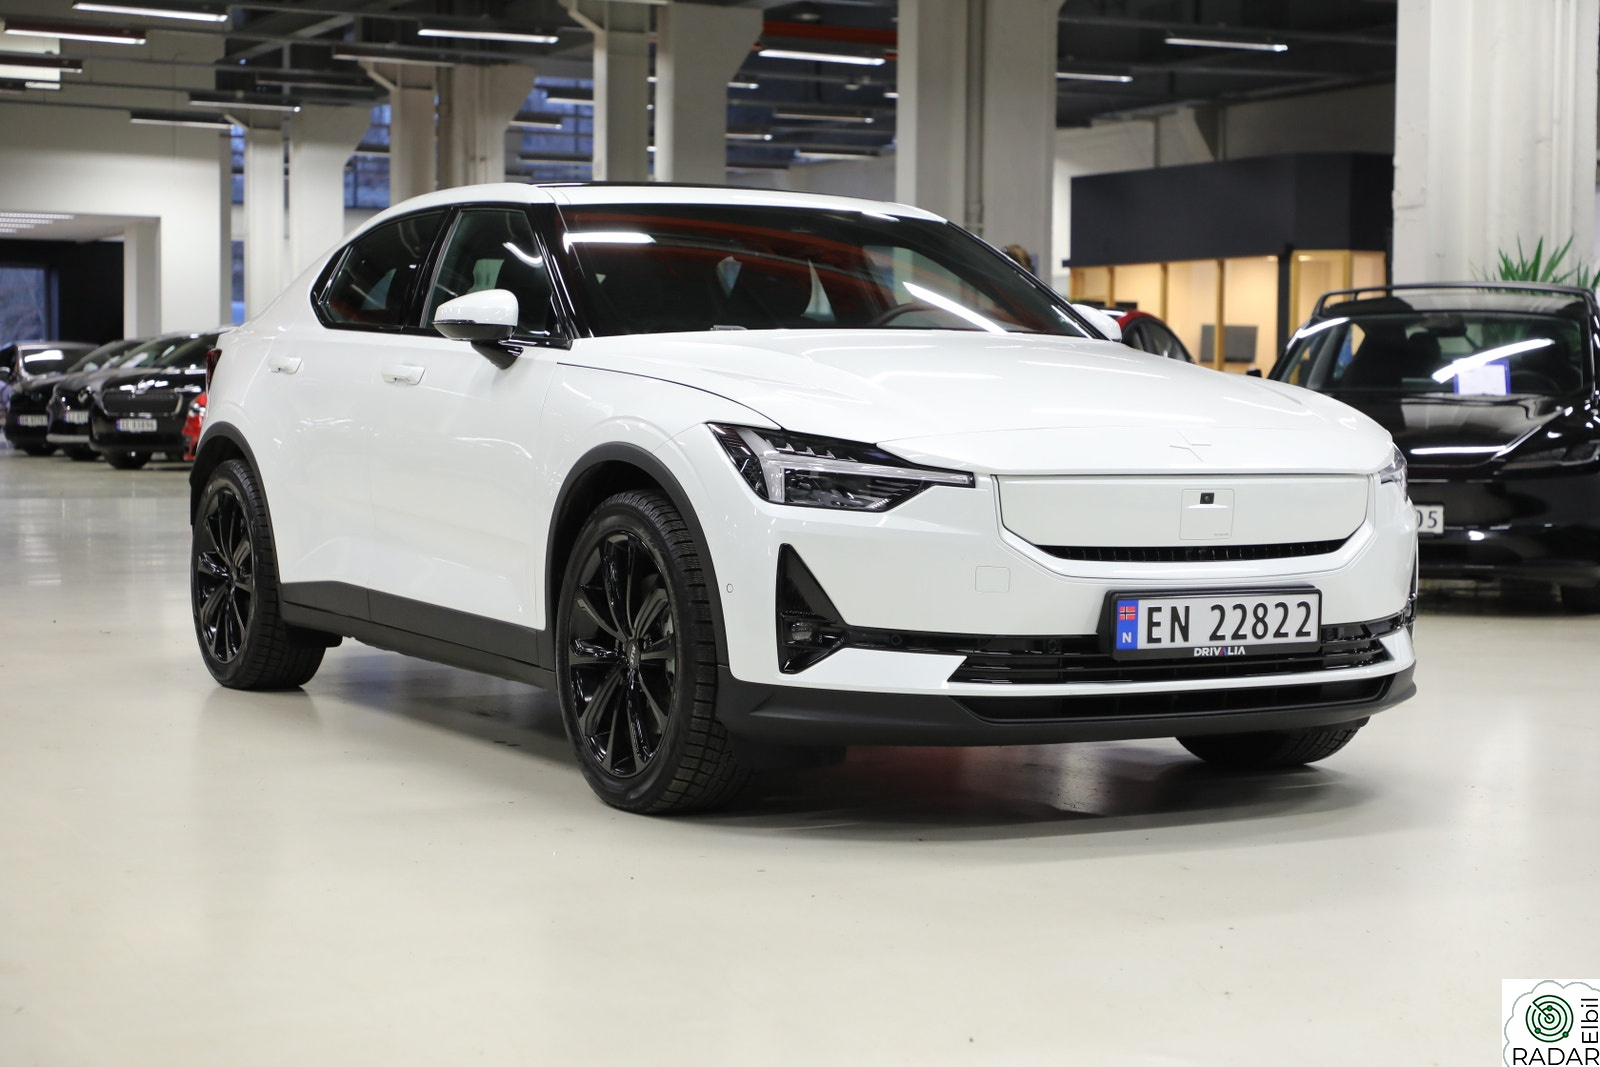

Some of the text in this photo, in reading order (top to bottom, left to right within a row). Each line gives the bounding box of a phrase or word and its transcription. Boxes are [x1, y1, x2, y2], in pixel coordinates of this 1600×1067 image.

[1147, 601, 1311, 643] EN 22822
[1122, 633, 1132, 643] N
[1194, 646, 1246, 657] DRIVALIA
